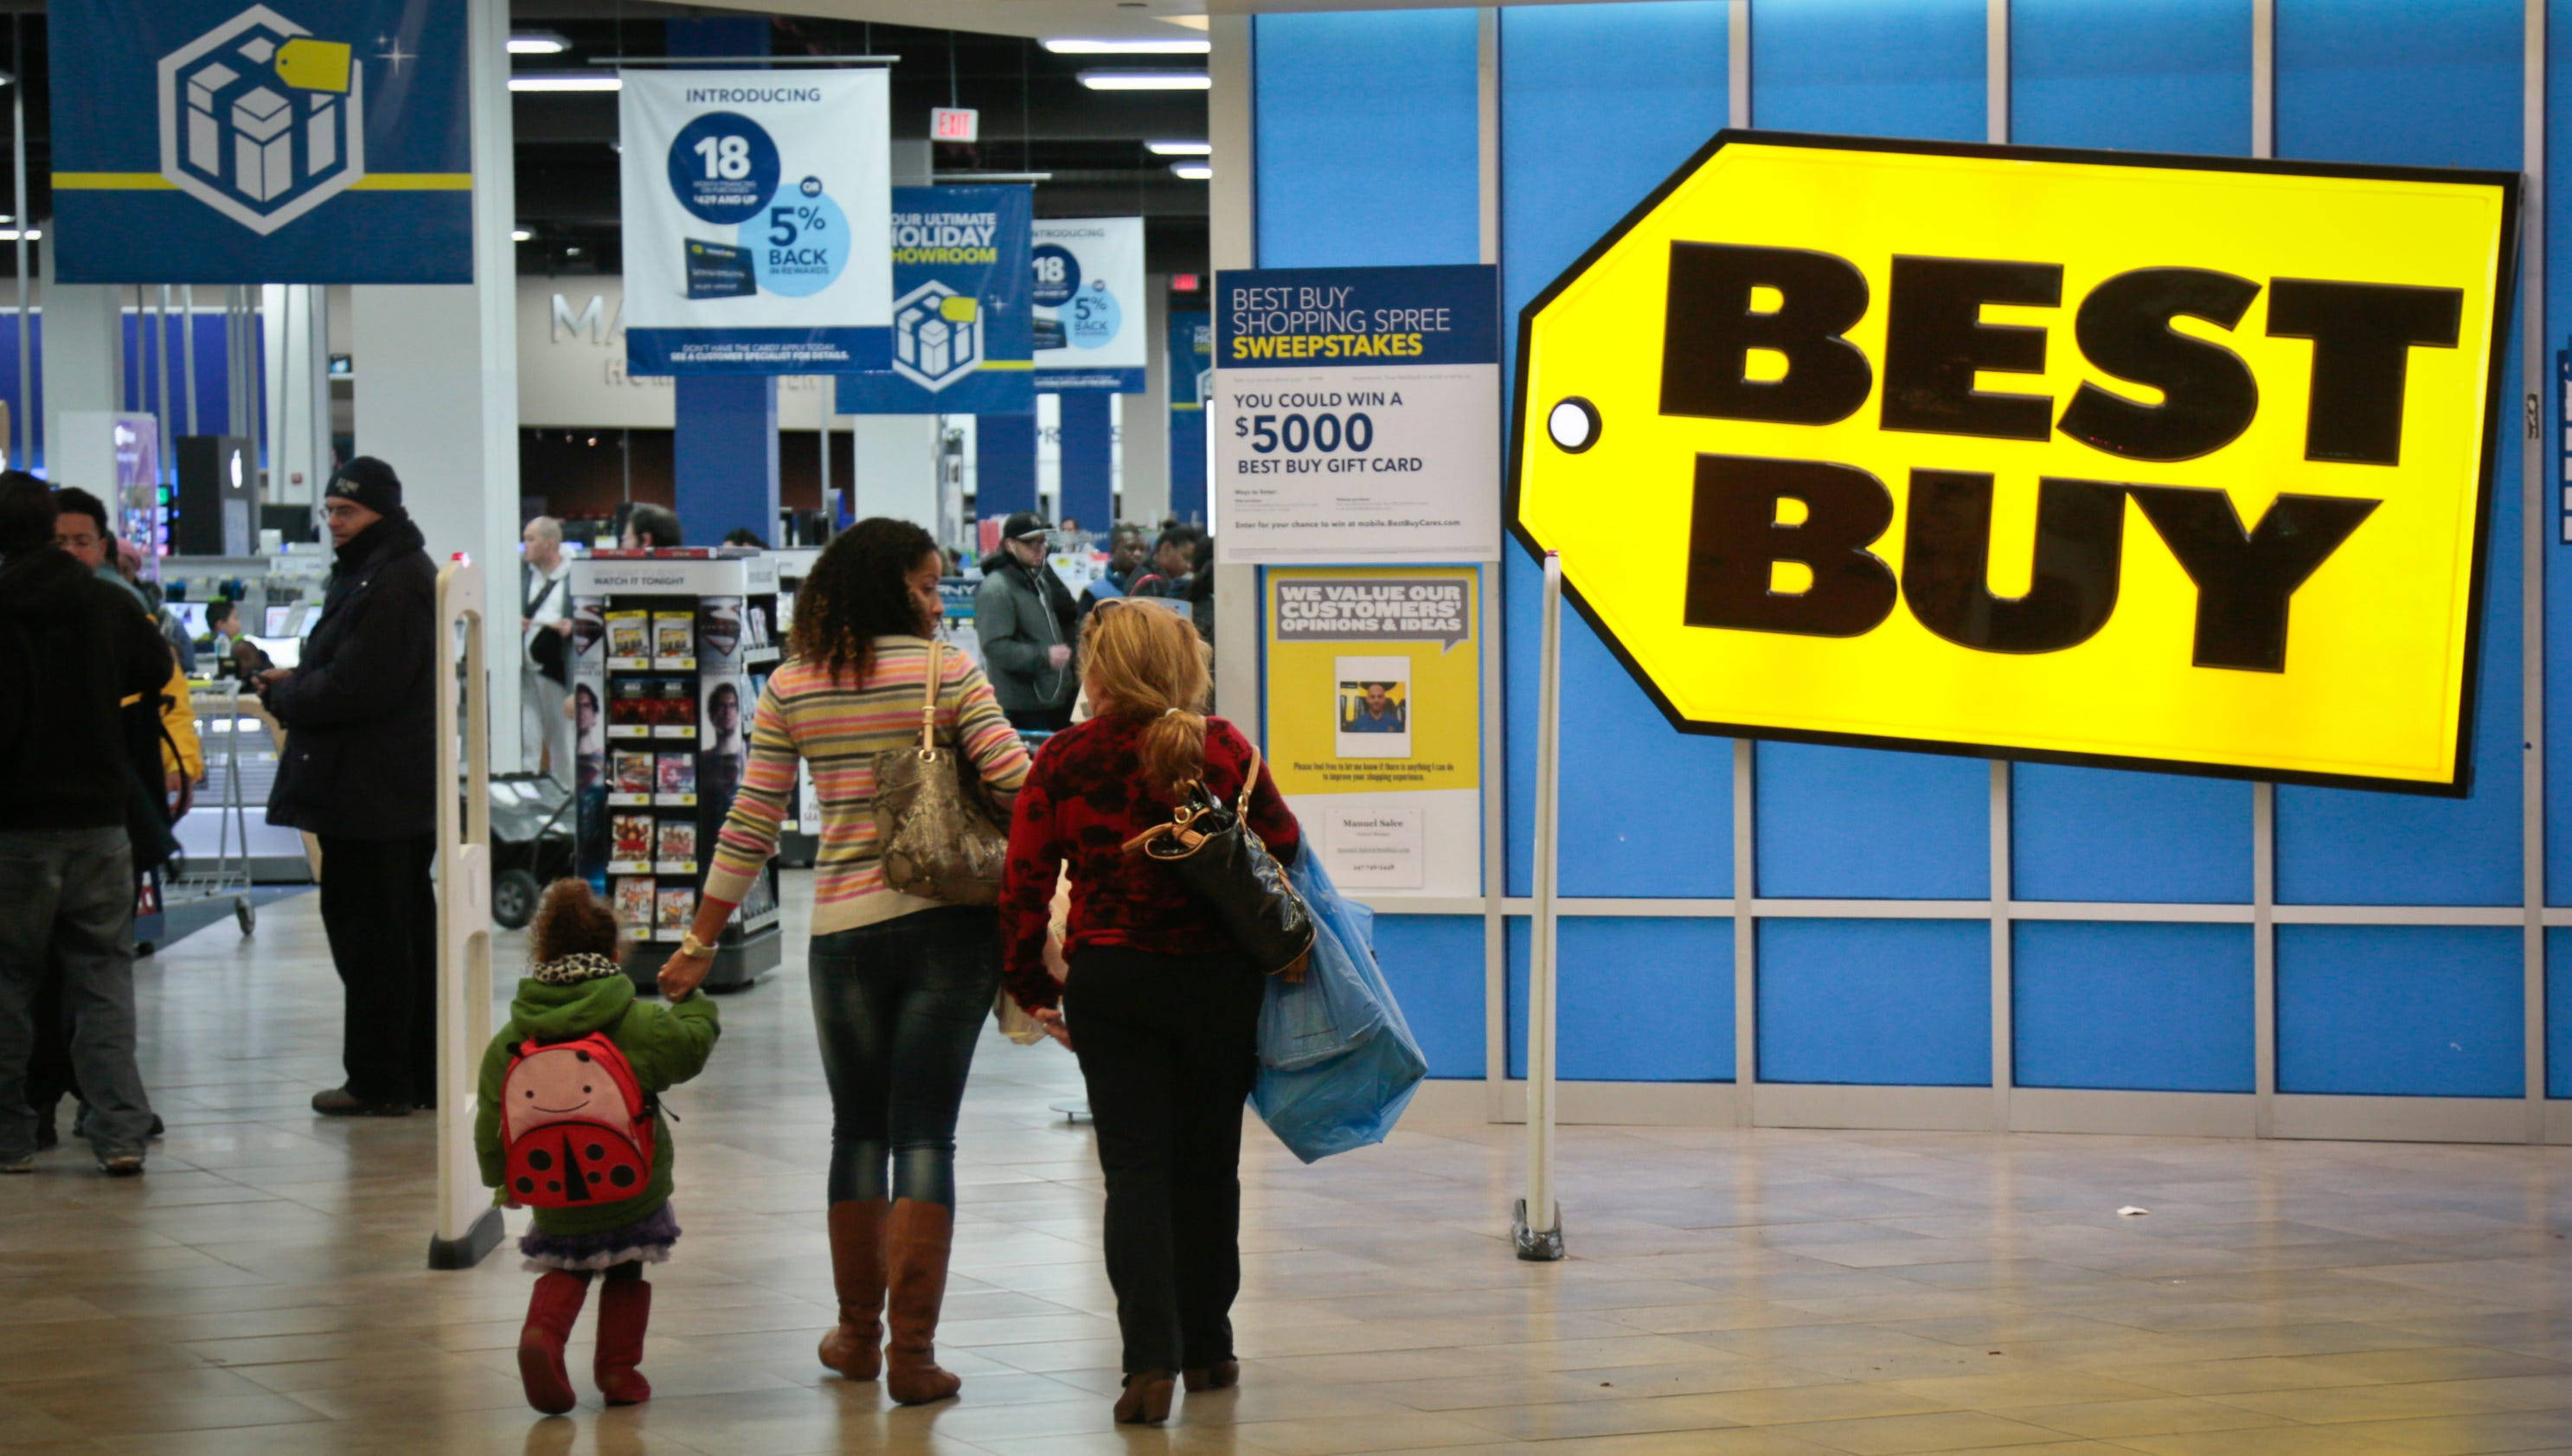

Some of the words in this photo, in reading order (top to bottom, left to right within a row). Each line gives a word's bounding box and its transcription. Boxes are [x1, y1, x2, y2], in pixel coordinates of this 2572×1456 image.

[686, 88, 821, 102] INTRODUCING
[938, 112, 971, 138] EXIT
[694, 135, 751, 180] 18
[802, 181, 821, 192] OR
[717, 195, 741, 206] AND
[741, 195, 758, 206] UP
[768, 206, 826, 247] 5%
[892, 213, 922, 226] OUR
[925, 213, 997, 226] ULTIMATE
[1032, 228, 1105, 237] NTRODUCING
[769, 248, 828, 266] BACK
[892, 247, 997, 264] HOWROOM
[781, 266, 829, 275] REWARDS
[1032, 256, 1065, 283] 18
[1233, 287, 1292, 311] BEST
[1300, 286, 1350, 310] BUY
[1074, 297, 1107, 320] 5%
[1074, 321, 1107, 331] BACK
[1233, 310, 1367, 335] SHOPPING
[1374, 308, 1452, 332] SPREE
[1233, 333, 1424, 360] SWEEPSTAKES
[1658, 239, 2465, 469] BEST
[670, 352, 686, 362] SEE
[687, 352, 695, 361] A
[696, 352, 743, 361] CUSTOMER
[745, 351, 792, 361] SPECIALIST
[793, 351, 811, 361] FOR
[812, 350, 850, 361] DETAILS.
[1234, 394, 1273, 408] YOU
[1279, 393, 1342, 407] COULD
[1348, 392, 1385, 407] WIN
[1389, 392, 1403, 406] A
[1235, 412, 1374, 453] $5000
[1238, 459, 1281, 474] BEST
[1286, 459, 1322, 473] BUY
[1327, 459, 1367, 472] GIFT
[1372, 458, 1423, 472] CARD
[1683, 452, 2384, 676] BUY
[1280, 587, 1322, 601] WE
[1324, 586, 1405, 600] VALUE
[1409, 586, 1461, 600] OUR
[1280, 600, 1462, 619] CUSTOMERS'
[1281, 619, 1379, 632] OPINIONS
[1382, 619, 1397, 631] &
[1400, 618, 1462, 631] IDEAS
[1293, 762, 1312, 771] Please
[1313, 762, 1324, 771] feel
[1324, 762, 1336, 771] free
[1363, 762, 1377, 771] know
[1384, 762, 1400, 771] there
[1407, 762, 1431, 773] anything
[1446, 762, 1454, 771] do
[1329, 773, 1351, 782] improve
[1367, 773, 1391, 782] shopping
[1344, 818, 1377, 827] Manuel
